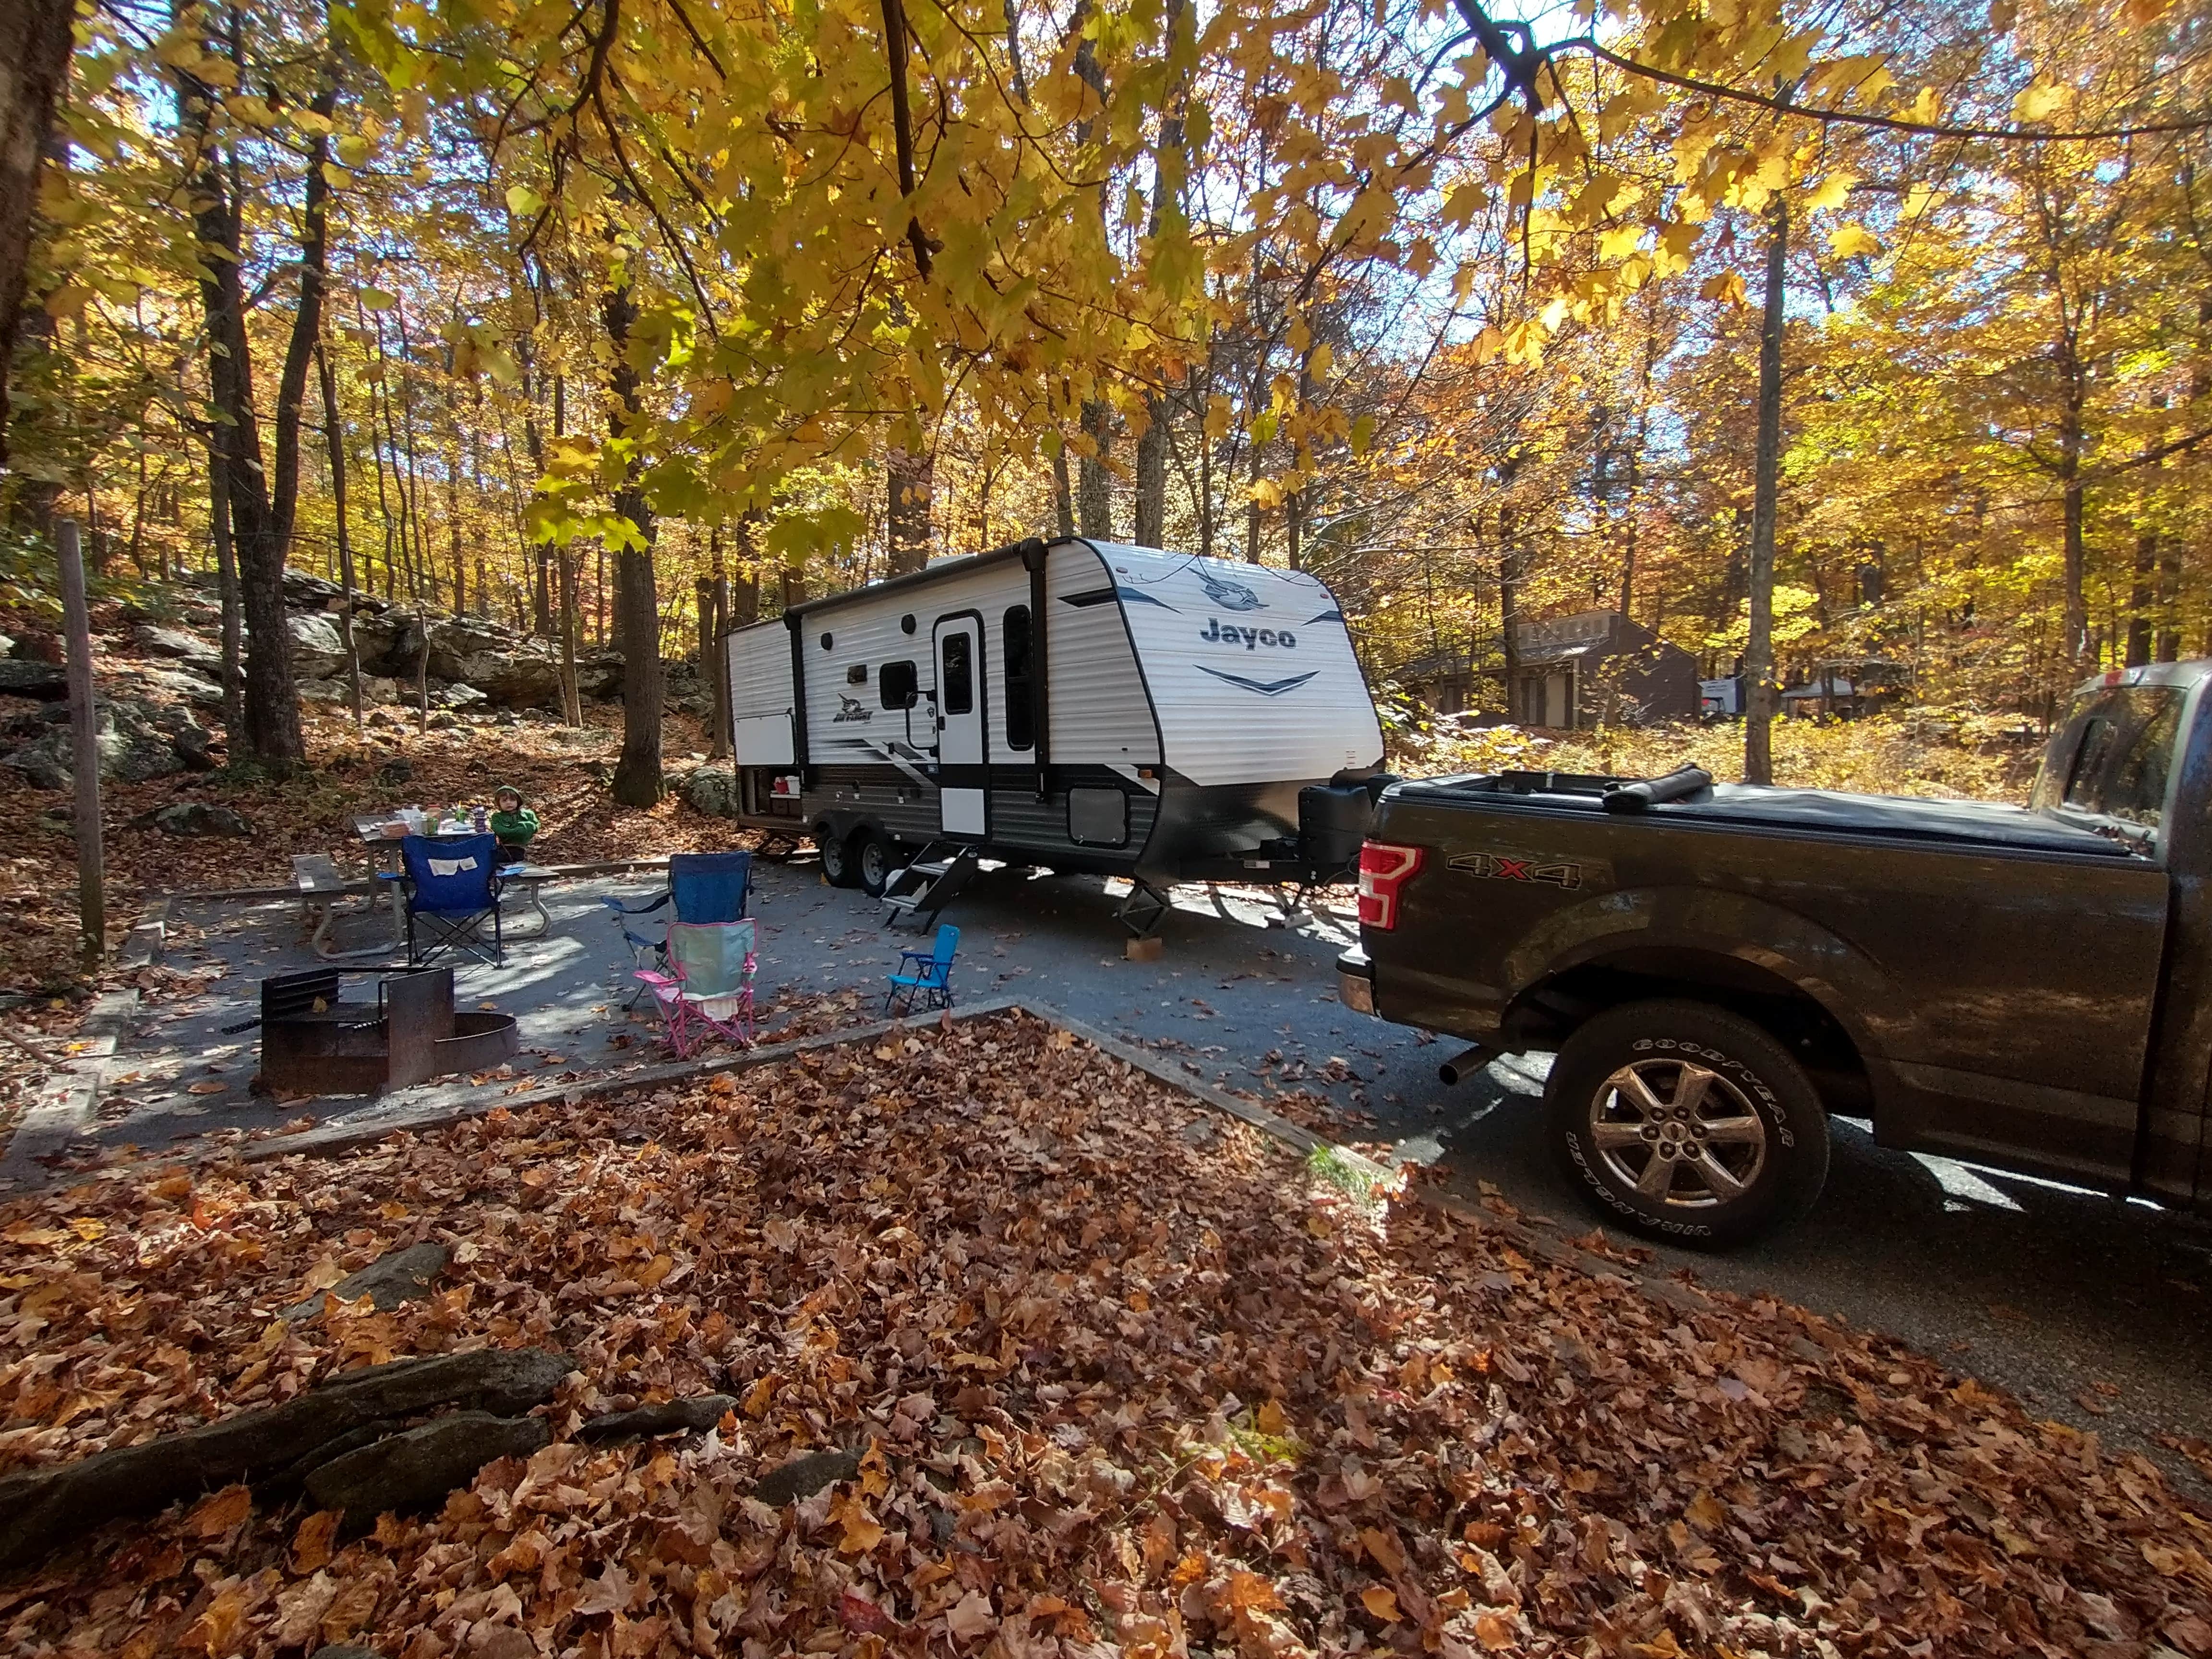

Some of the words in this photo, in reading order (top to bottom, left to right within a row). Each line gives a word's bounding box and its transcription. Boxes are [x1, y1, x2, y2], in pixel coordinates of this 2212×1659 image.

[1200, 617, 1297, 651] Jayco
[1446, 853, 1581, 890] 4X4
[1633, 1039, 1794, 1147] GOODYEAR
[1566, 1131, 1711, 1236] WRANGLER
